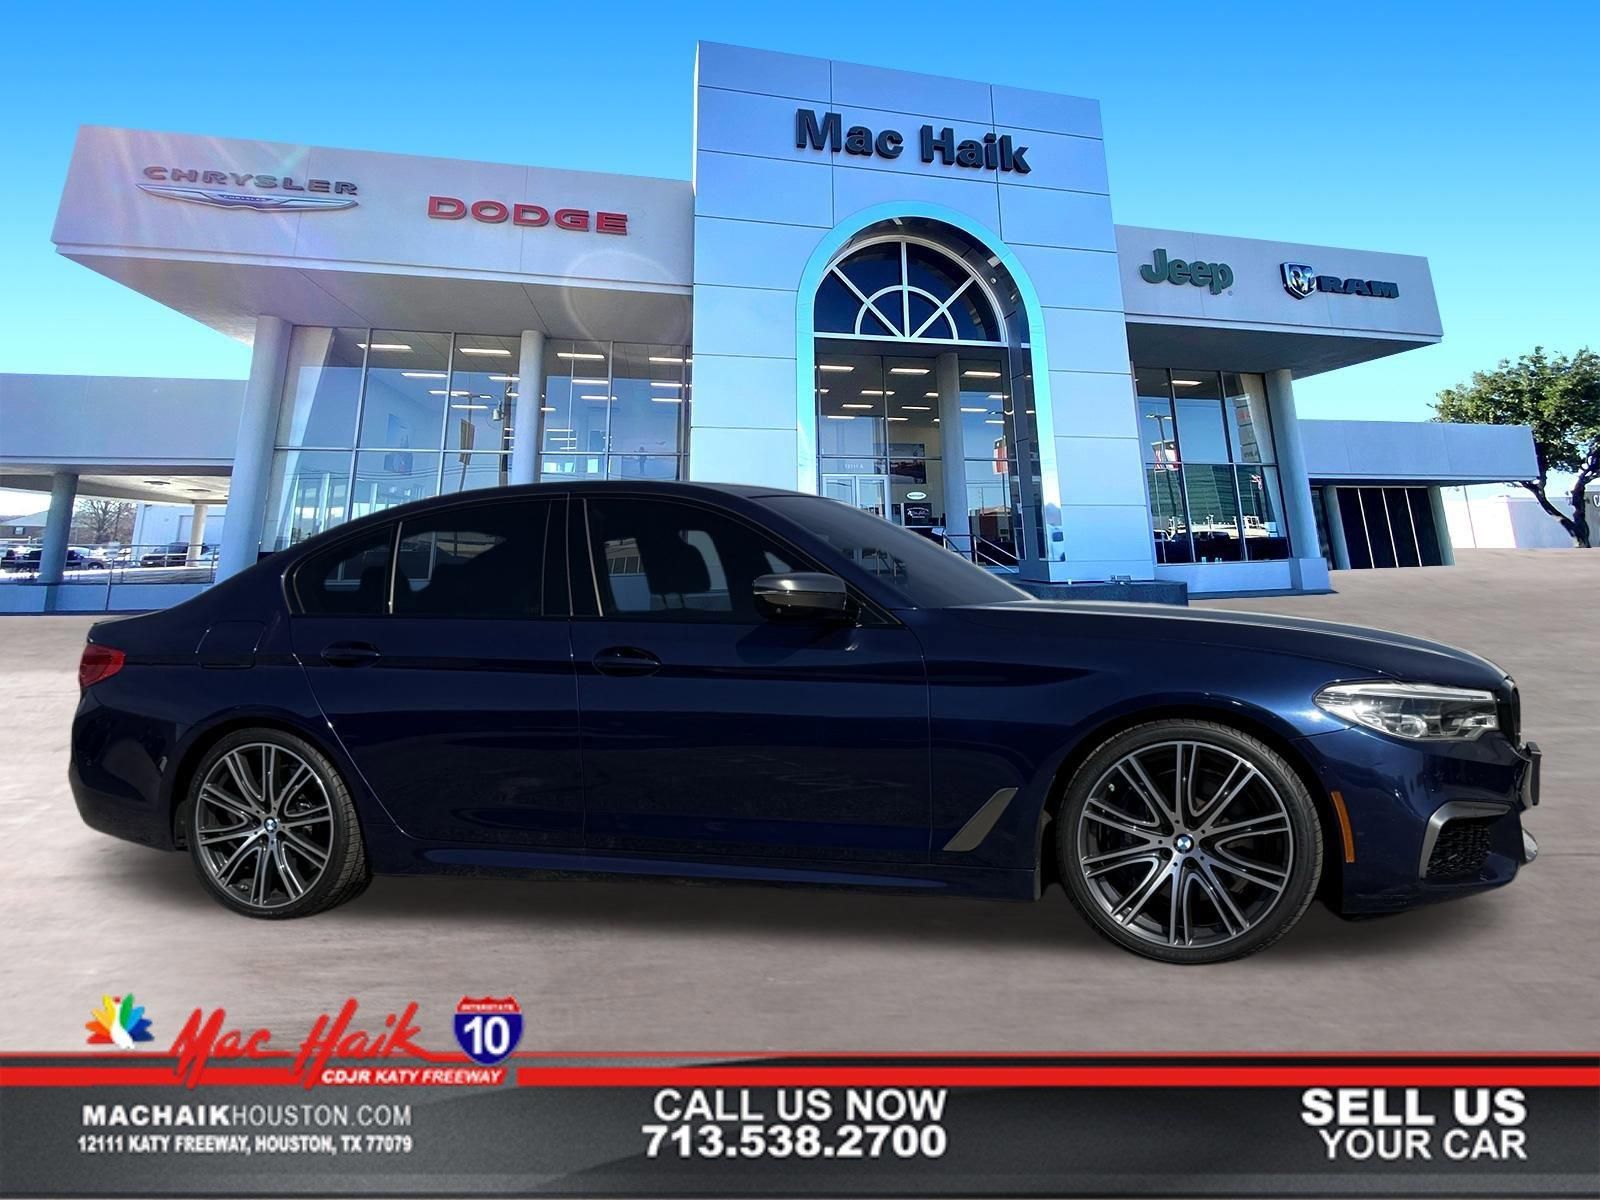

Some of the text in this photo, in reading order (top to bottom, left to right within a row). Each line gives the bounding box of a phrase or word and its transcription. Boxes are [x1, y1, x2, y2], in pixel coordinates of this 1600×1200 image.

[796, 108, 1032, 174] Mac Haik
[143, 166, 358, 195] CHRYSLER
[428, 195, 628, 236] DODGE
[1140, 248, 1234, 295] Jeep
[1316, 275, 1399, 298] RAM
